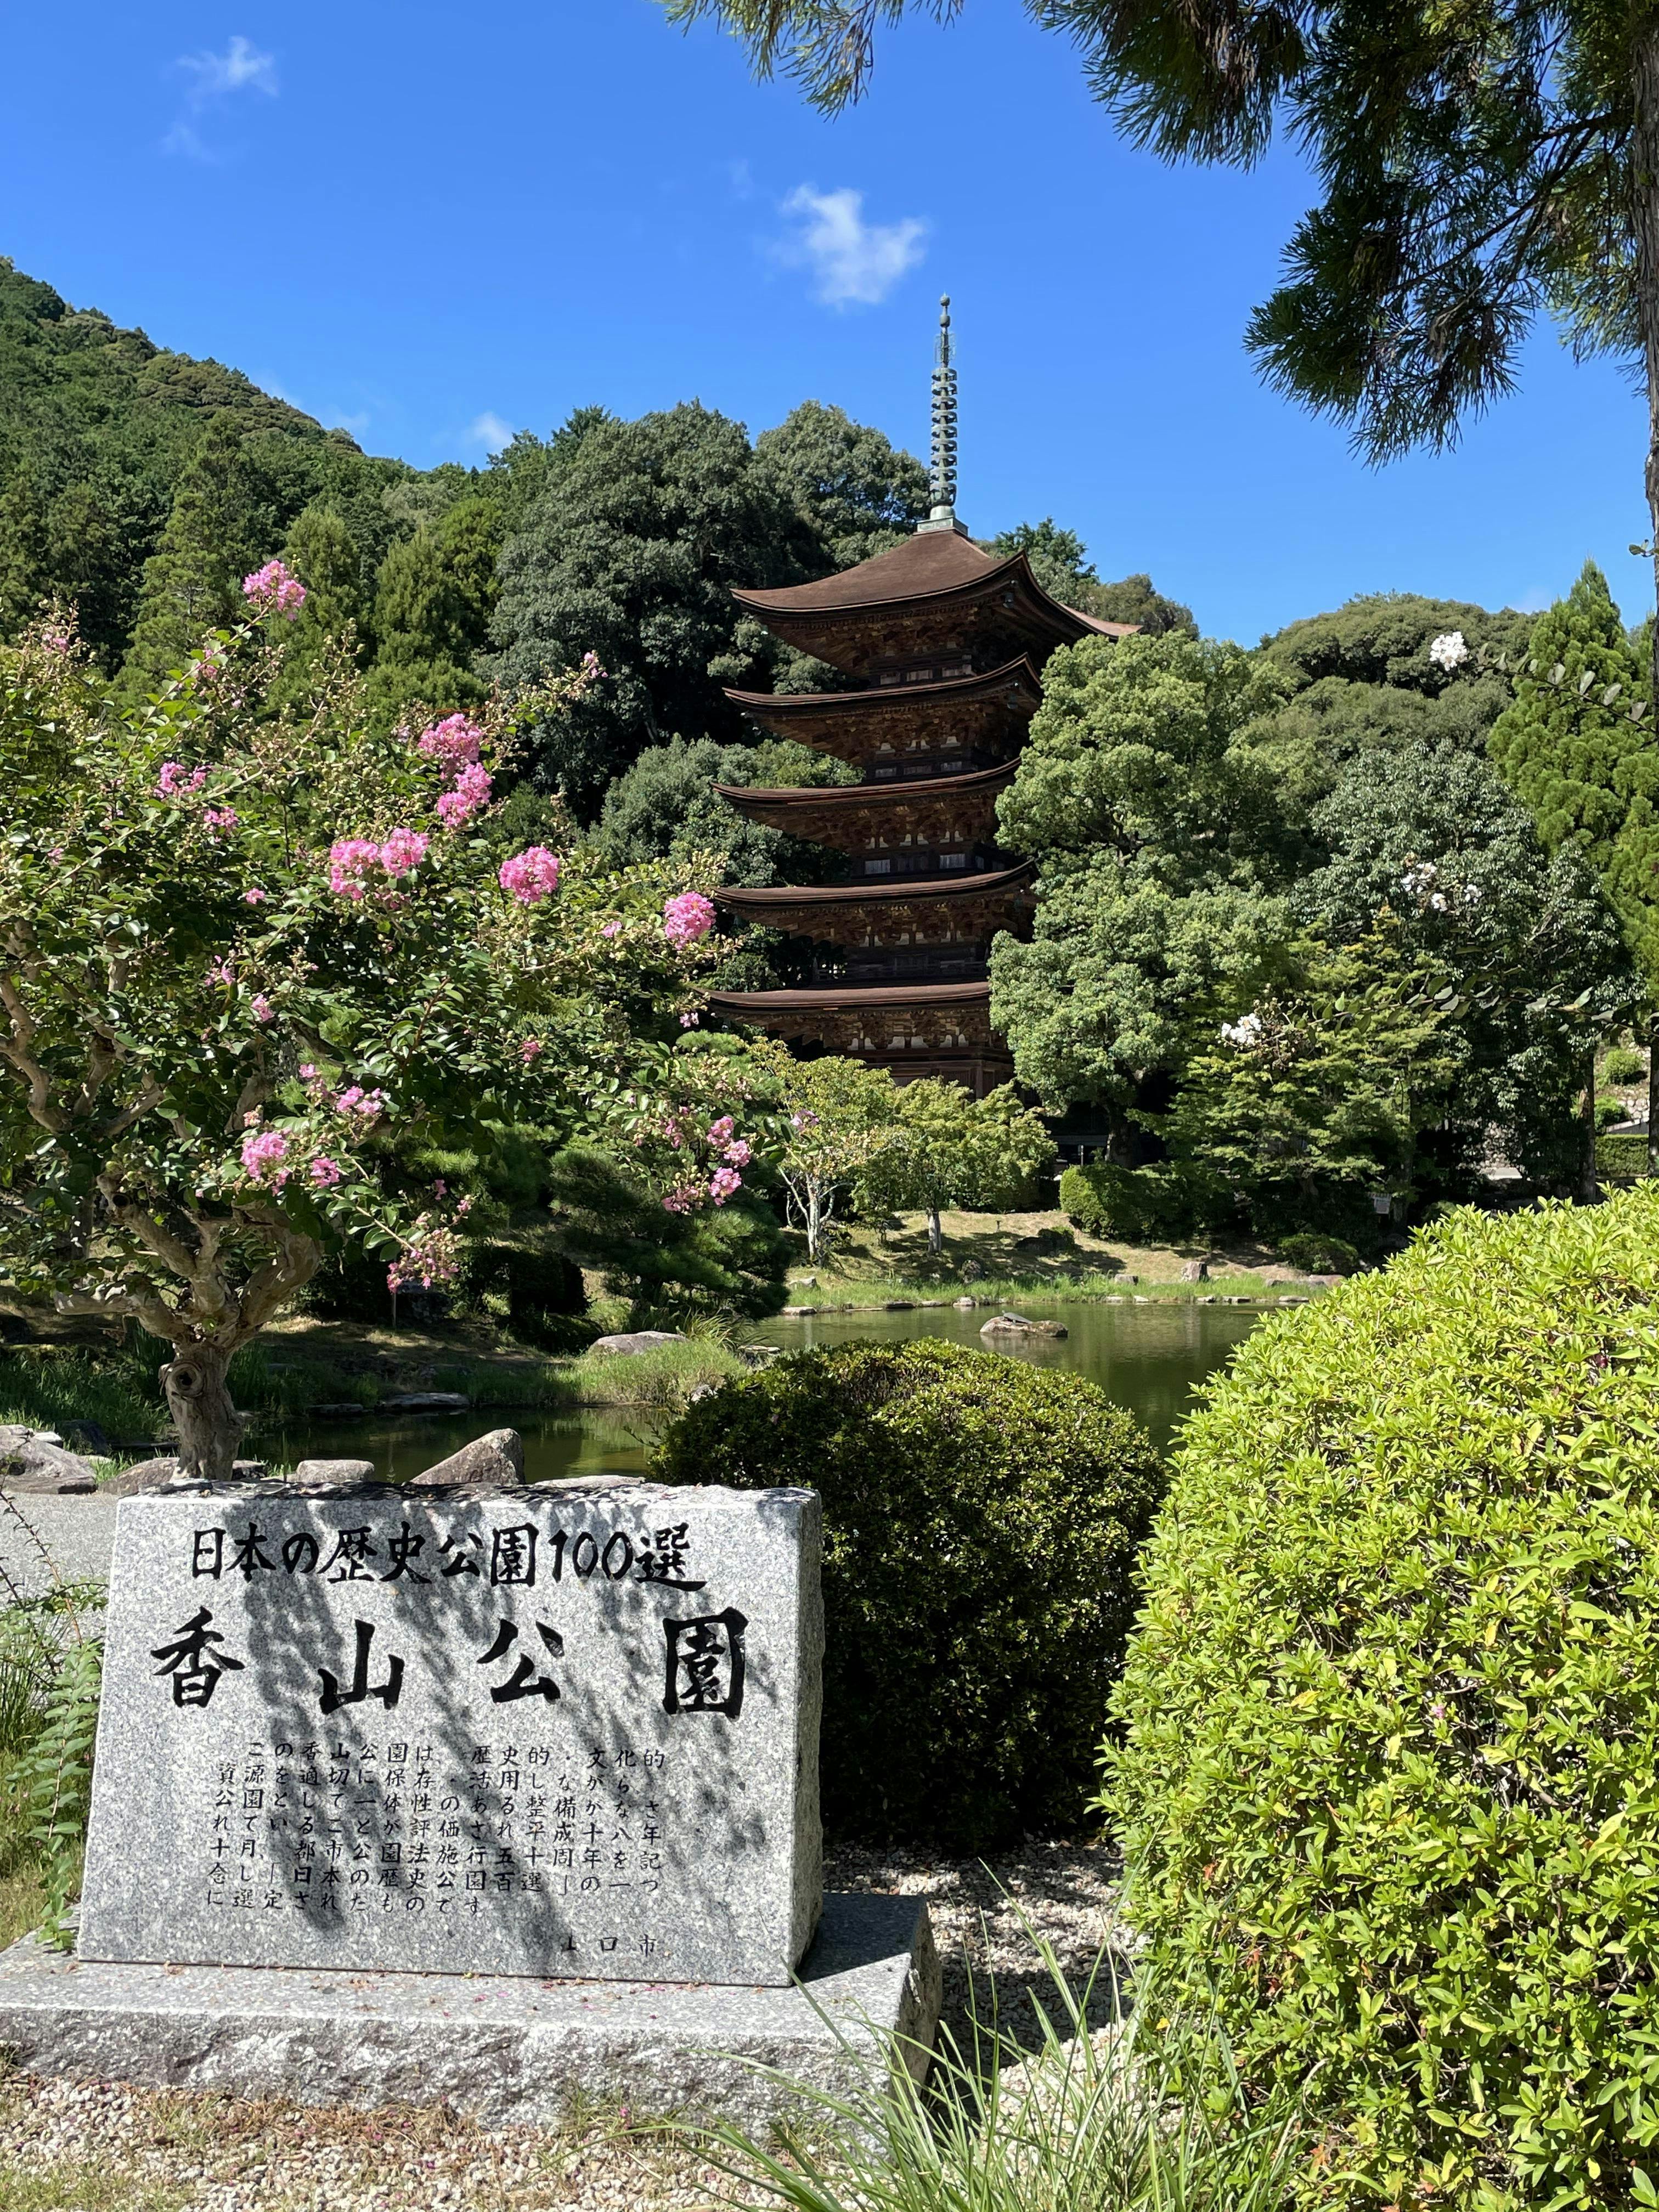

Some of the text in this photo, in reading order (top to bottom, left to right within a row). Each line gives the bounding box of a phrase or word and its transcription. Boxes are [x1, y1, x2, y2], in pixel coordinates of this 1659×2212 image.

[192, 1521, 708, 1591] 日本の歴史公園100選
[150, 1606, 749, 1719] 香山公園
[216, 1788, 661, 1819] 公園として一体性のある整備がなさ
[207, 1889, 479, 1915] に選定されたものです
